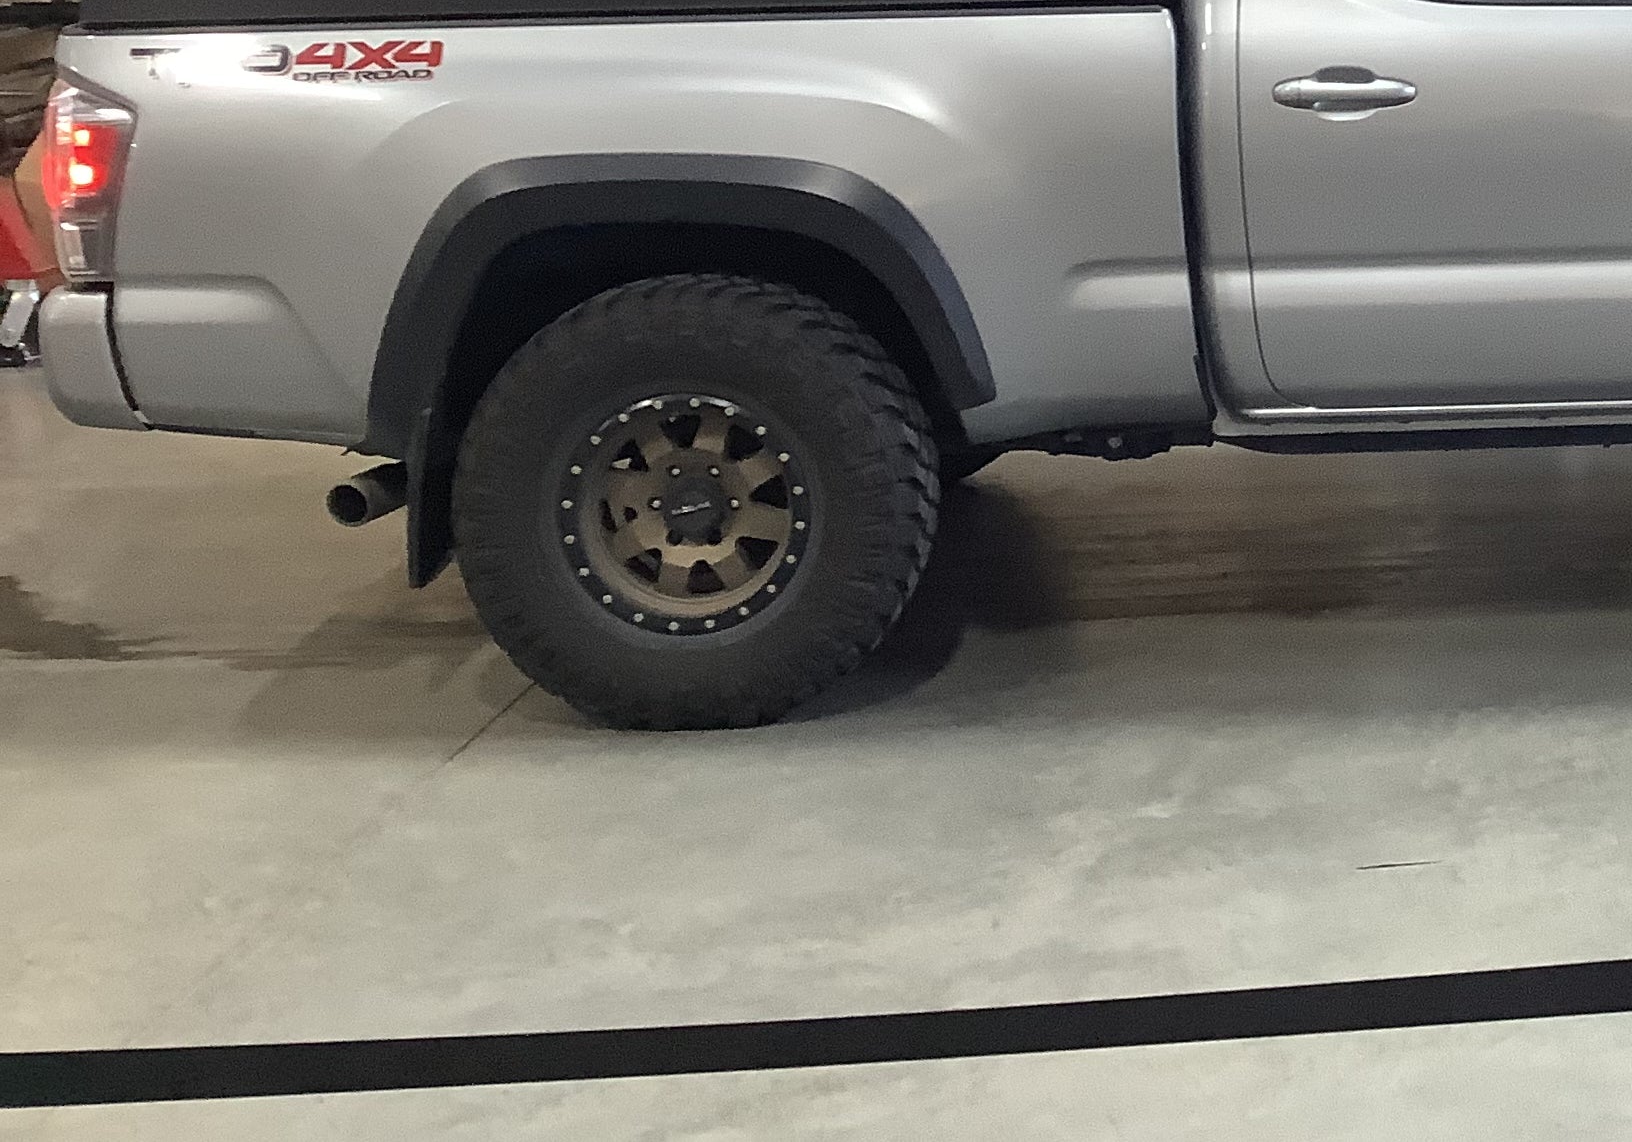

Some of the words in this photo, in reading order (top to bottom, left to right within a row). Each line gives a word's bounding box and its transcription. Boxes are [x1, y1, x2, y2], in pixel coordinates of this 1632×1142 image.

[294, 40, 445, 70] 4X4
[293, 71, 351, 83] OFF
[354, 69, 433, 81] ROAD
